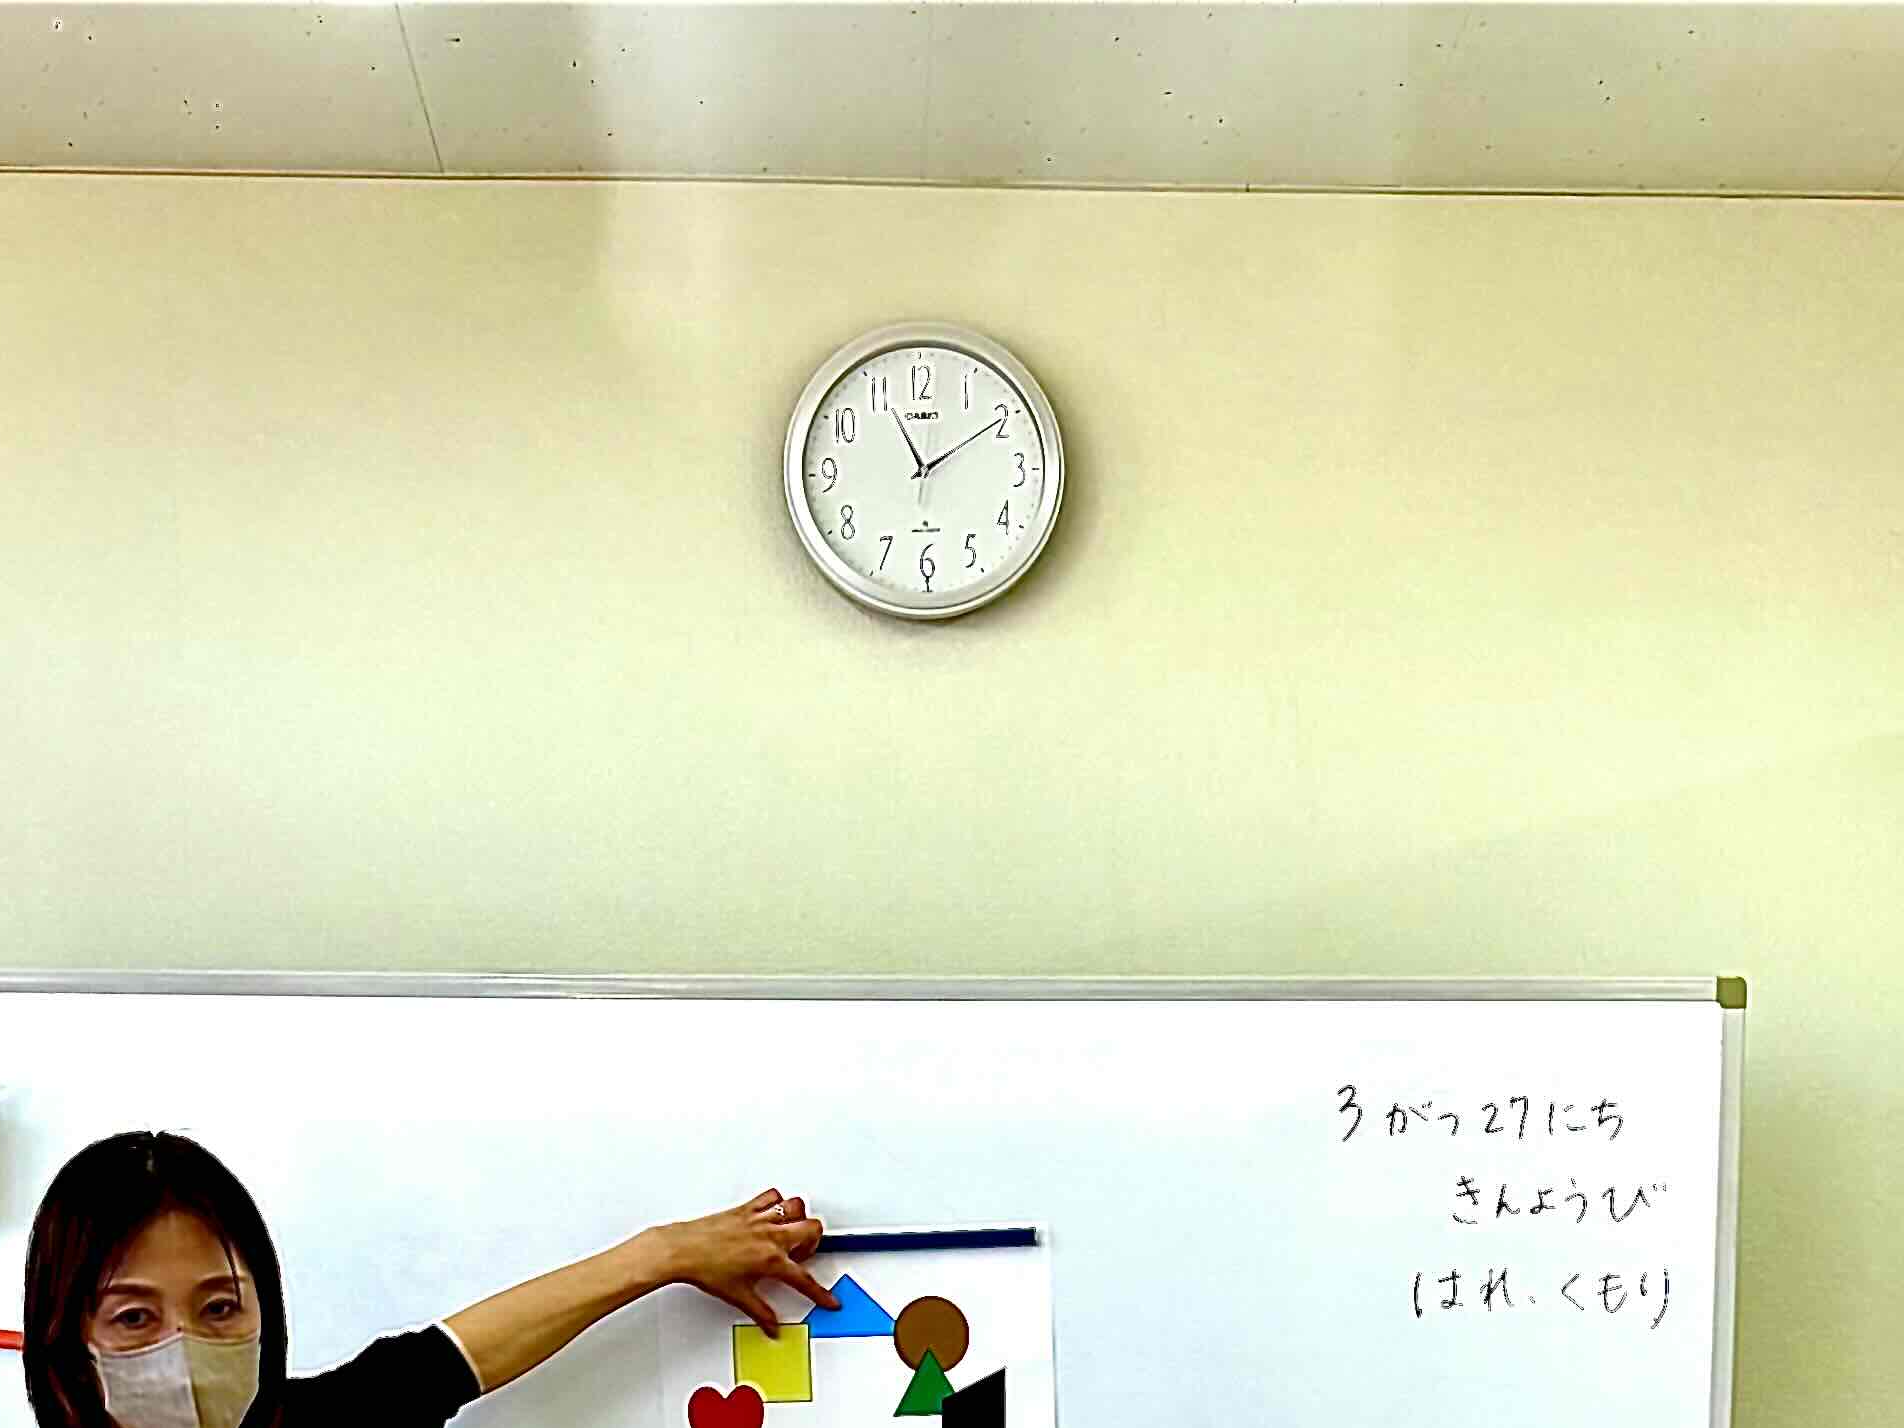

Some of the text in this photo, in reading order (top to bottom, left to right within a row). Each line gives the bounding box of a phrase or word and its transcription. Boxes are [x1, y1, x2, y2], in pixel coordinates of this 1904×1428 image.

[871, 376, 888, 413] 11
[911, 364, 933, 401] 12
[962, 374, 970, 411] 1
[834, 407, 856, 444] 10
[994, 403, 1010, 439] 2
[821, 456, 838, 494] 9
[1013, 452, 1026, 488] 3
[840, 503, 856, 541] 8
[996, 498, 1010, 536] 4
[879, 535, 894, 571] 7
[919, 543, 936, 580] 6
[964, 533, 977, 569] 5
[1451, 1175, 1668, 1225] きんようび
